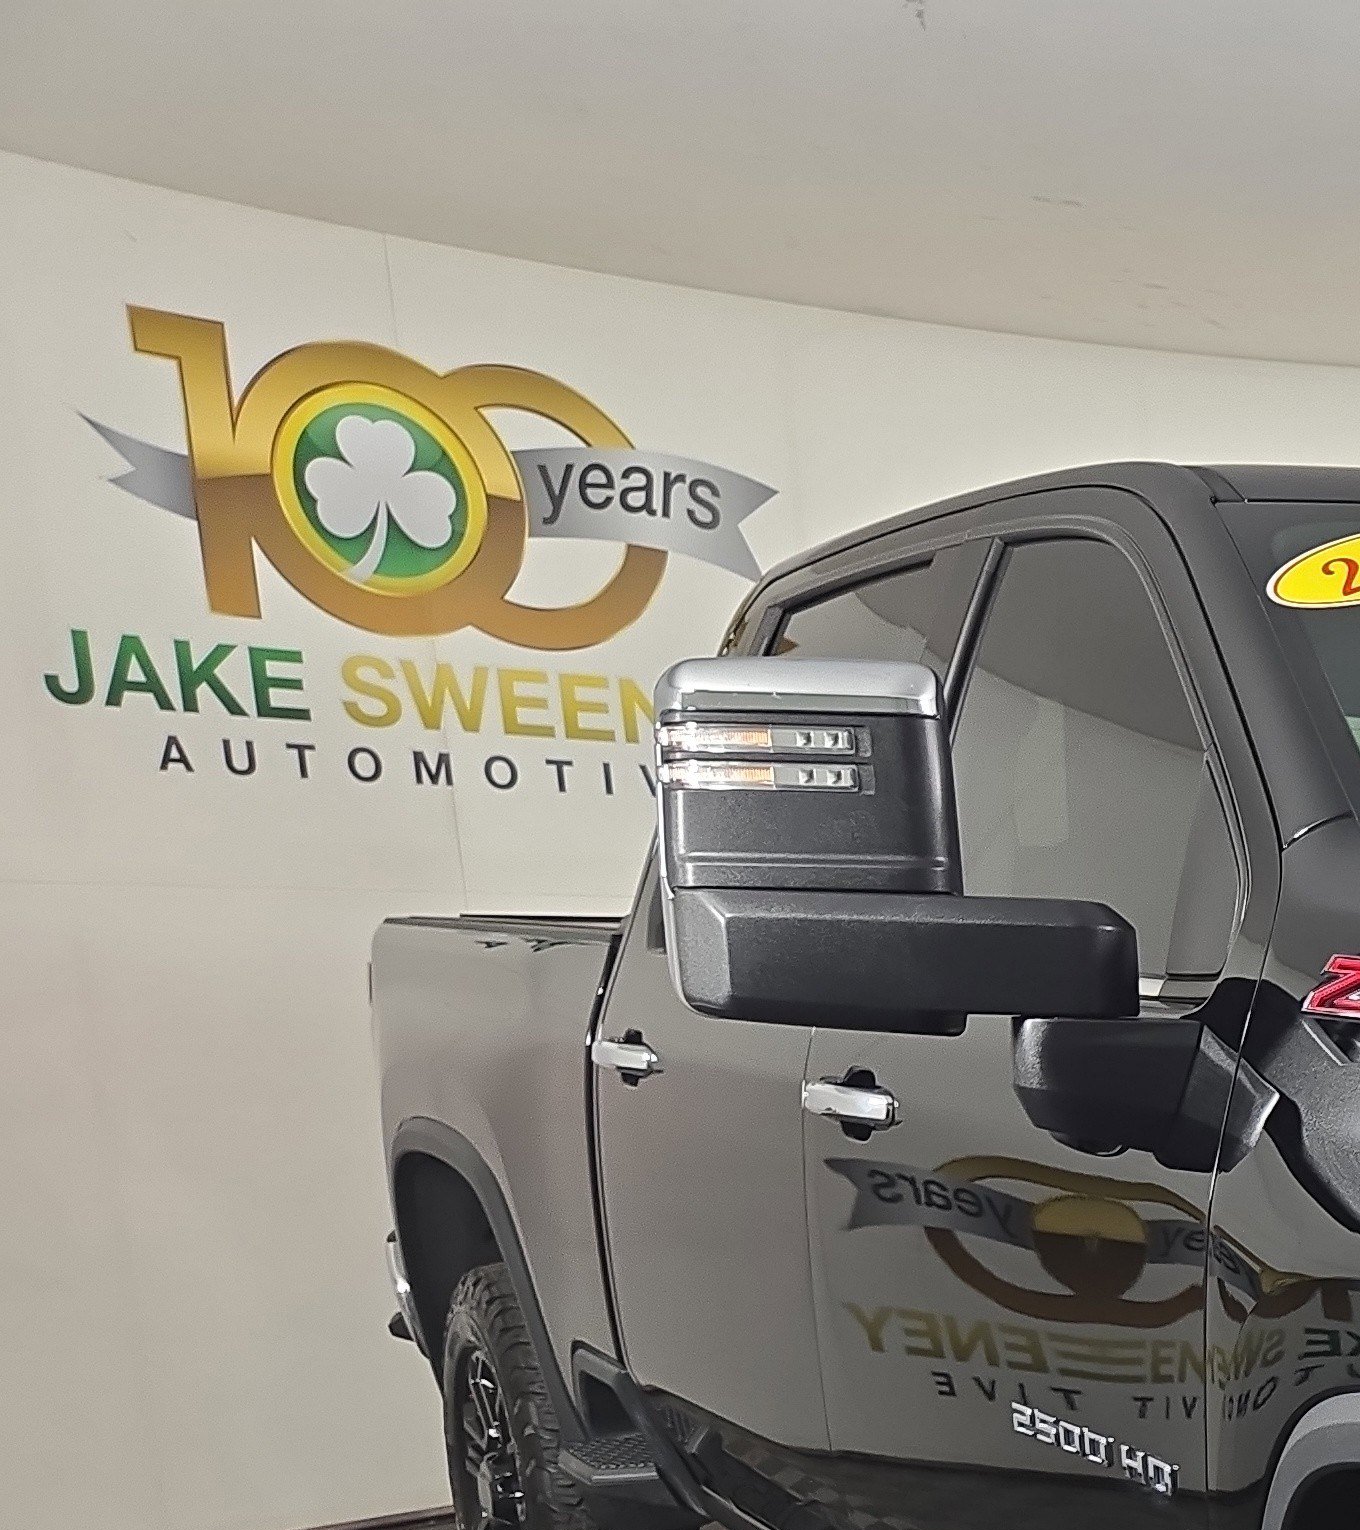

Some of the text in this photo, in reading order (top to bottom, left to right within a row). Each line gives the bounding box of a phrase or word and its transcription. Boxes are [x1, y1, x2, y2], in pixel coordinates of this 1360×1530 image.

[536, 462, 722, 532] years
[43, 629, 655, 744] JAKE SWEEN
[159, 734, 657, 797] AUTOMOTI
